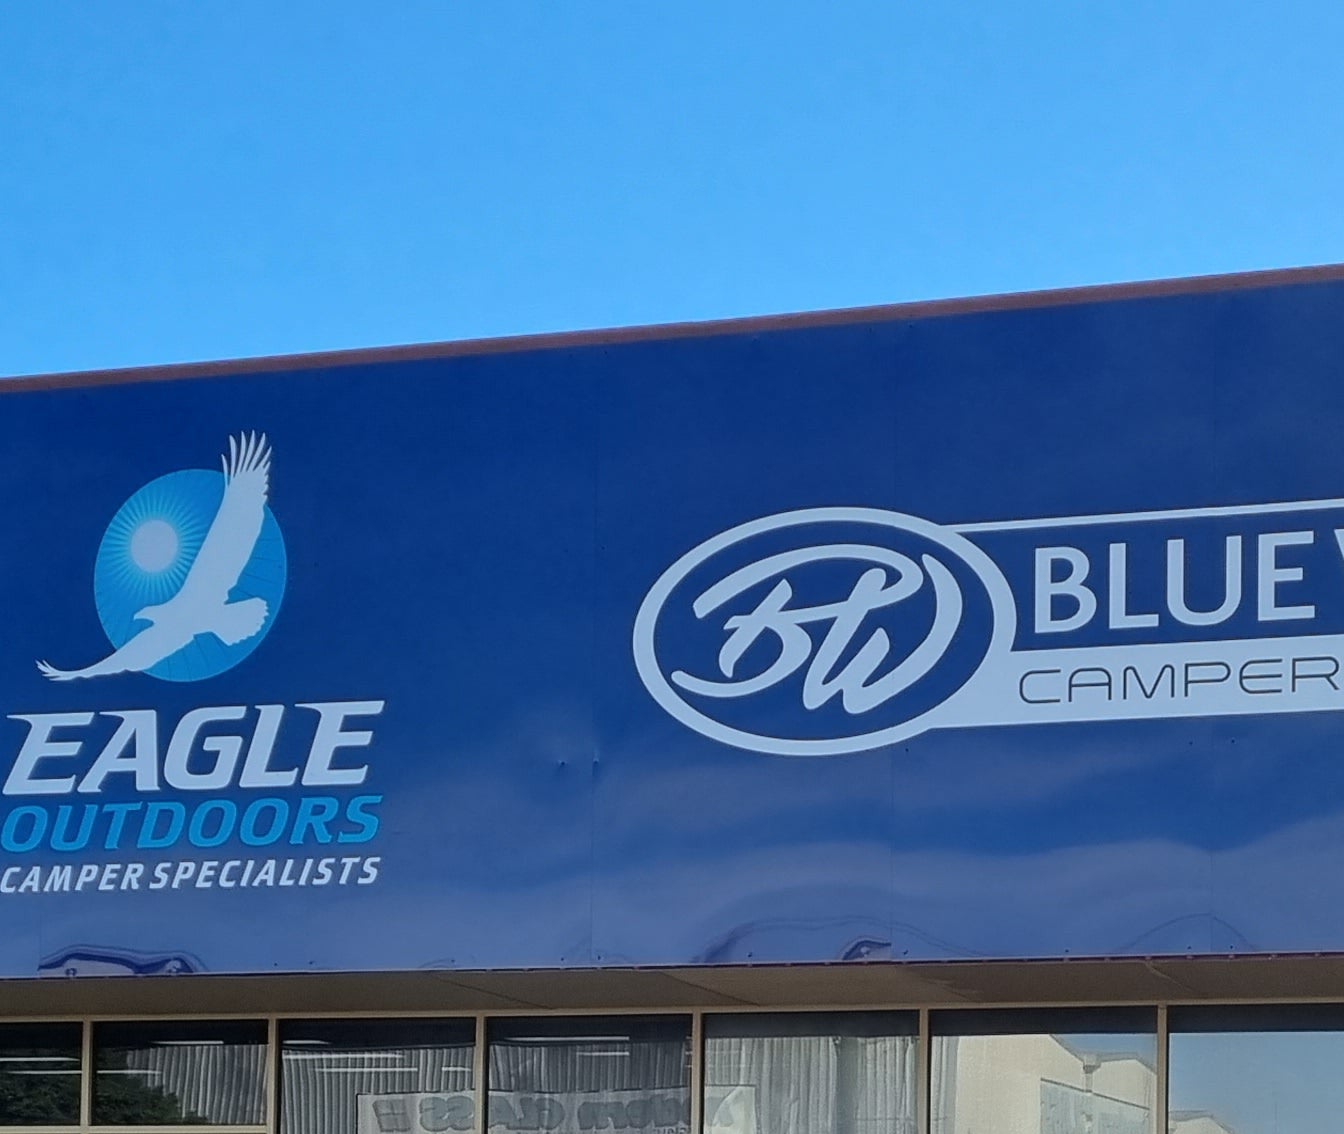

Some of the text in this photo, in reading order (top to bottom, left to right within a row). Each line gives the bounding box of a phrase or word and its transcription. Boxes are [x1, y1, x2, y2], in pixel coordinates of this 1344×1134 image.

[1, 699, 386, 796] EAGLE
[0, 794, 384, 853] OUTDOORS
[148, 855, 383, 891] SPECIALISTS
